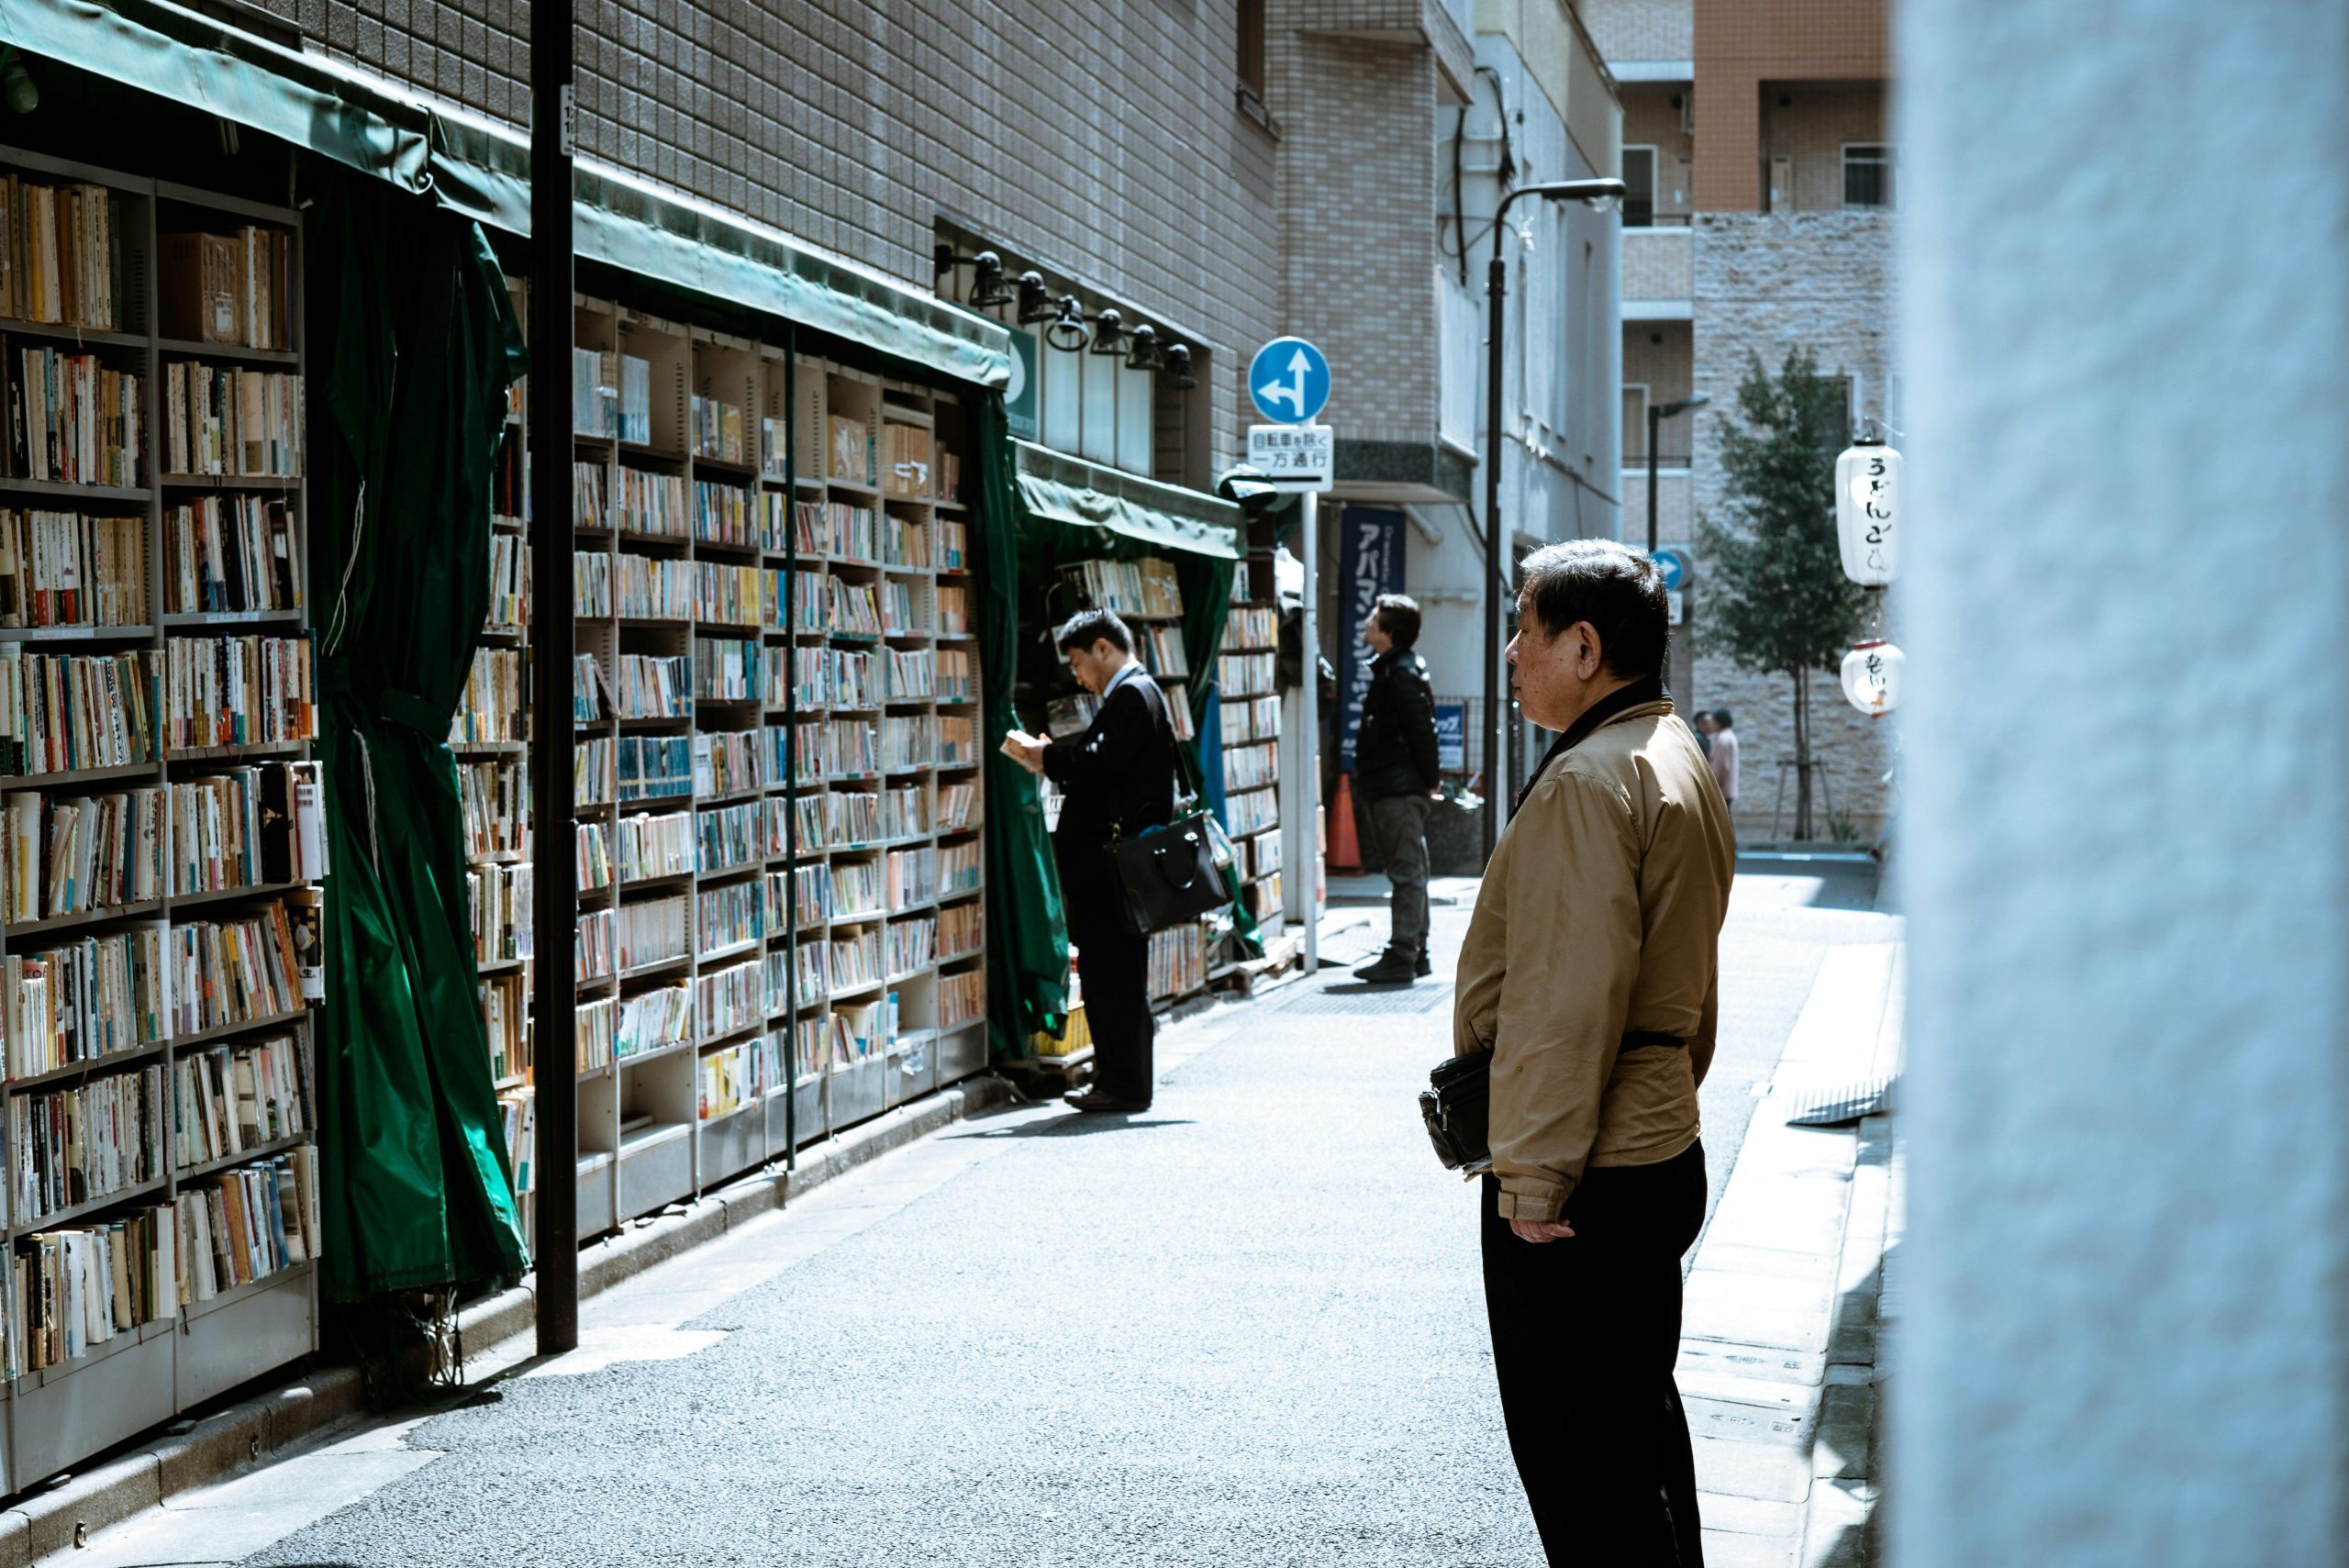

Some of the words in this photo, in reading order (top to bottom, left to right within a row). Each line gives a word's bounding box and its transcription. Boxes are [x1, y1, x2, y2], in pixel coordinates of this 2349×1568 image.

[1253, 432, 1327, 449] 自転車を除く
[1253, 452, 1327, 468] 一方通行
